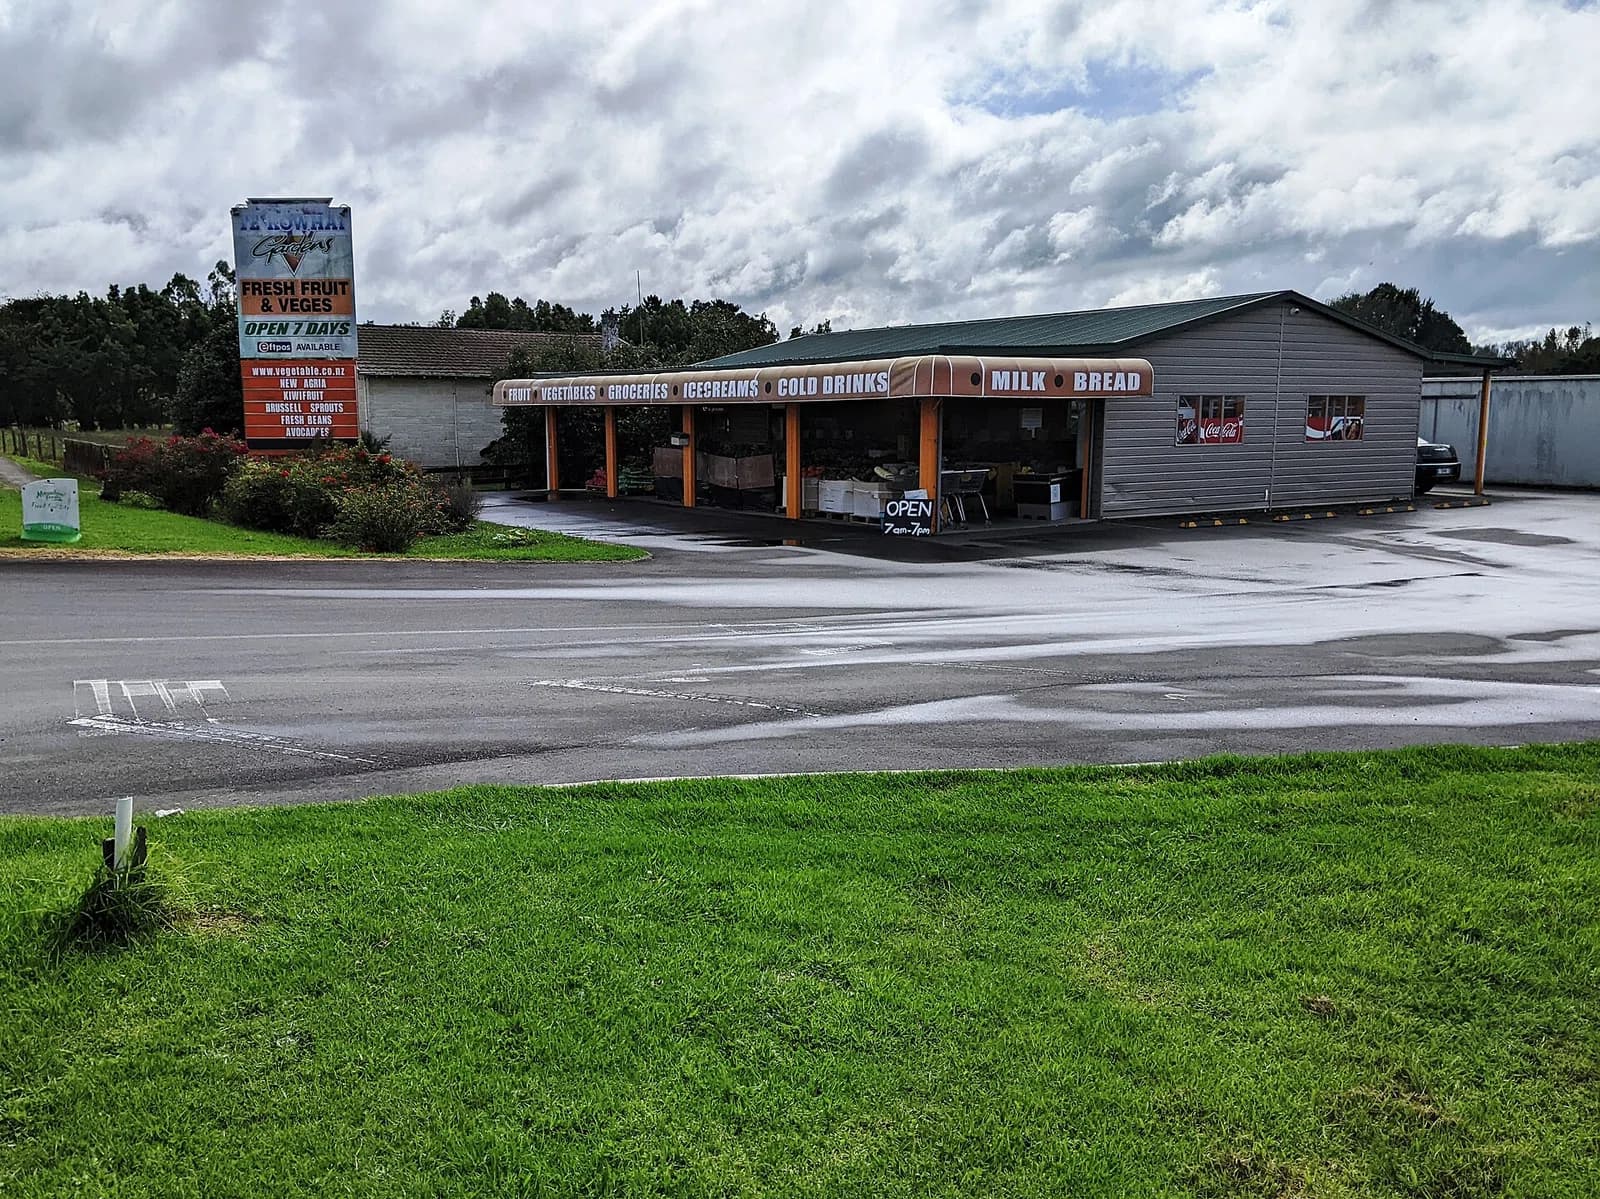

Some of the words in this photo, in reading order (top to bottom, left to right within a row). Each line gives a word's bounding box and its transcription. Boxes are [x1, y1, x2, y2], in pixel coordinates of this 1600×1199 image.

[252, 233, 334, 265] Gardens
[242, 282, 295, 295] FRESH
[301, 282, 349, 295] FRUIT
[261, 299, 273, 312] &
[279, 299, 332, 312] VEGES
[245, 322, 289, 335] OPEN
[294, 322, 302, 335] 7
[306, 322, 350, 335] DAYS
[259, 342, 291, 352] eftpos
[296, 343, 340, 351] AVAILABLE
[252, 366, 345, 377] www.vegetable.co.nz
[280, 379, 297, 388] NEW
[303, 379, 327, 388] AGRIA
[508, 388, 532, 401] FRUIT
[541, 385, 596, 401] VEGETABLES
[608, 383, 668, 400] GROCERIES
[683, 379, 759, 399] ICECREAMS
[777, 376, 818, 397] COLD
[823, 371, 889, 395] DRINKS
[991, 371, 1047, 391] MILK
[1073, 372, 1141, 391] BREAD
[283, 391, 324, 401] KIWIFRUIT
[265, 403, 302, 413] BRUSSELL
[310, 403, 344, 413] SPROUTS
[281, 415, 304, 425] FRESH
[308, 415, 332, 425] BEANS
[886, 500, 932, 517] OPEN
[884, 521, 930, 537] 7am-7pm
